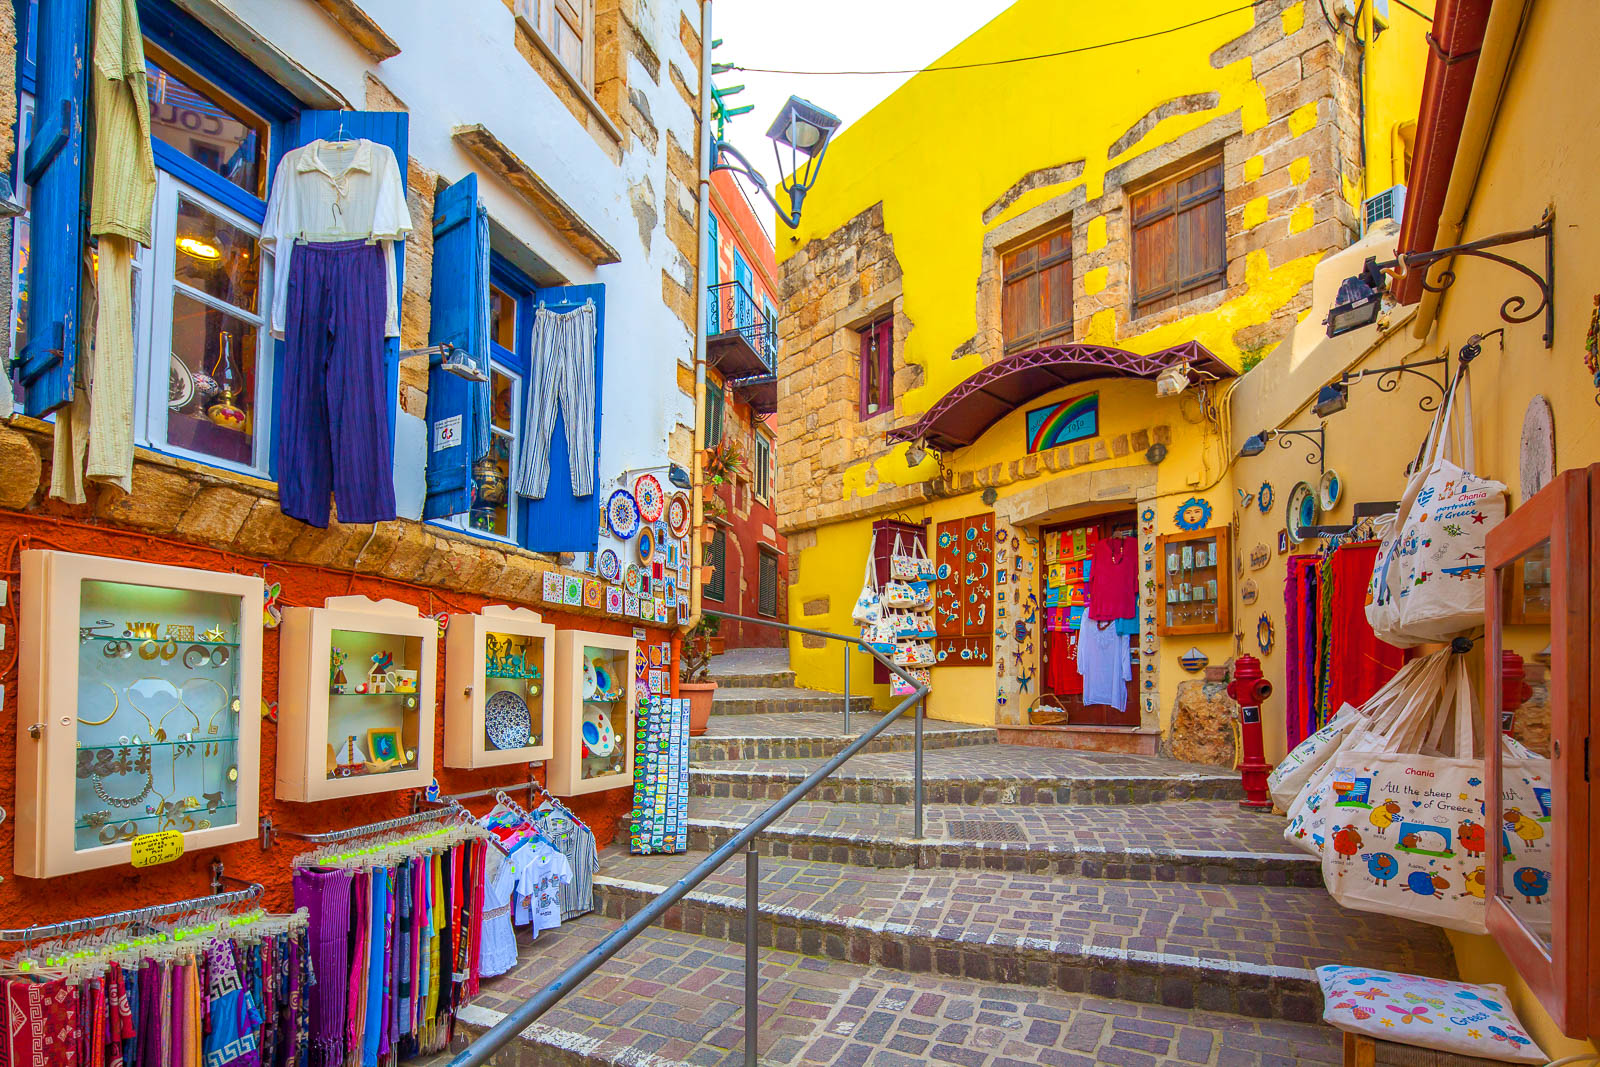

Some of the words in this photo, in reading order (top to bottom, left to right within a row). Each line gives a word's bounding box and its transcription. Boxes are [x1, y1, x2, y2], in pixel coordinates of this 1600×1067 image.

[1458, 491, 1487, 502] Chania
[1436, 500, 1476, 514] portraits
[1434, 513, 1442, 522] of
[1445, 509, 1478, 519] Greece
[1405, 767, 1435, 778] Chania
[1380, 780, 1400, 794] All
[1404, 784, 1420, 796] the
[1423, 786, 1452, 799] sheep
[1423, 799, 1434, 809] of
[1437, 801, 1474, 814] Greece
